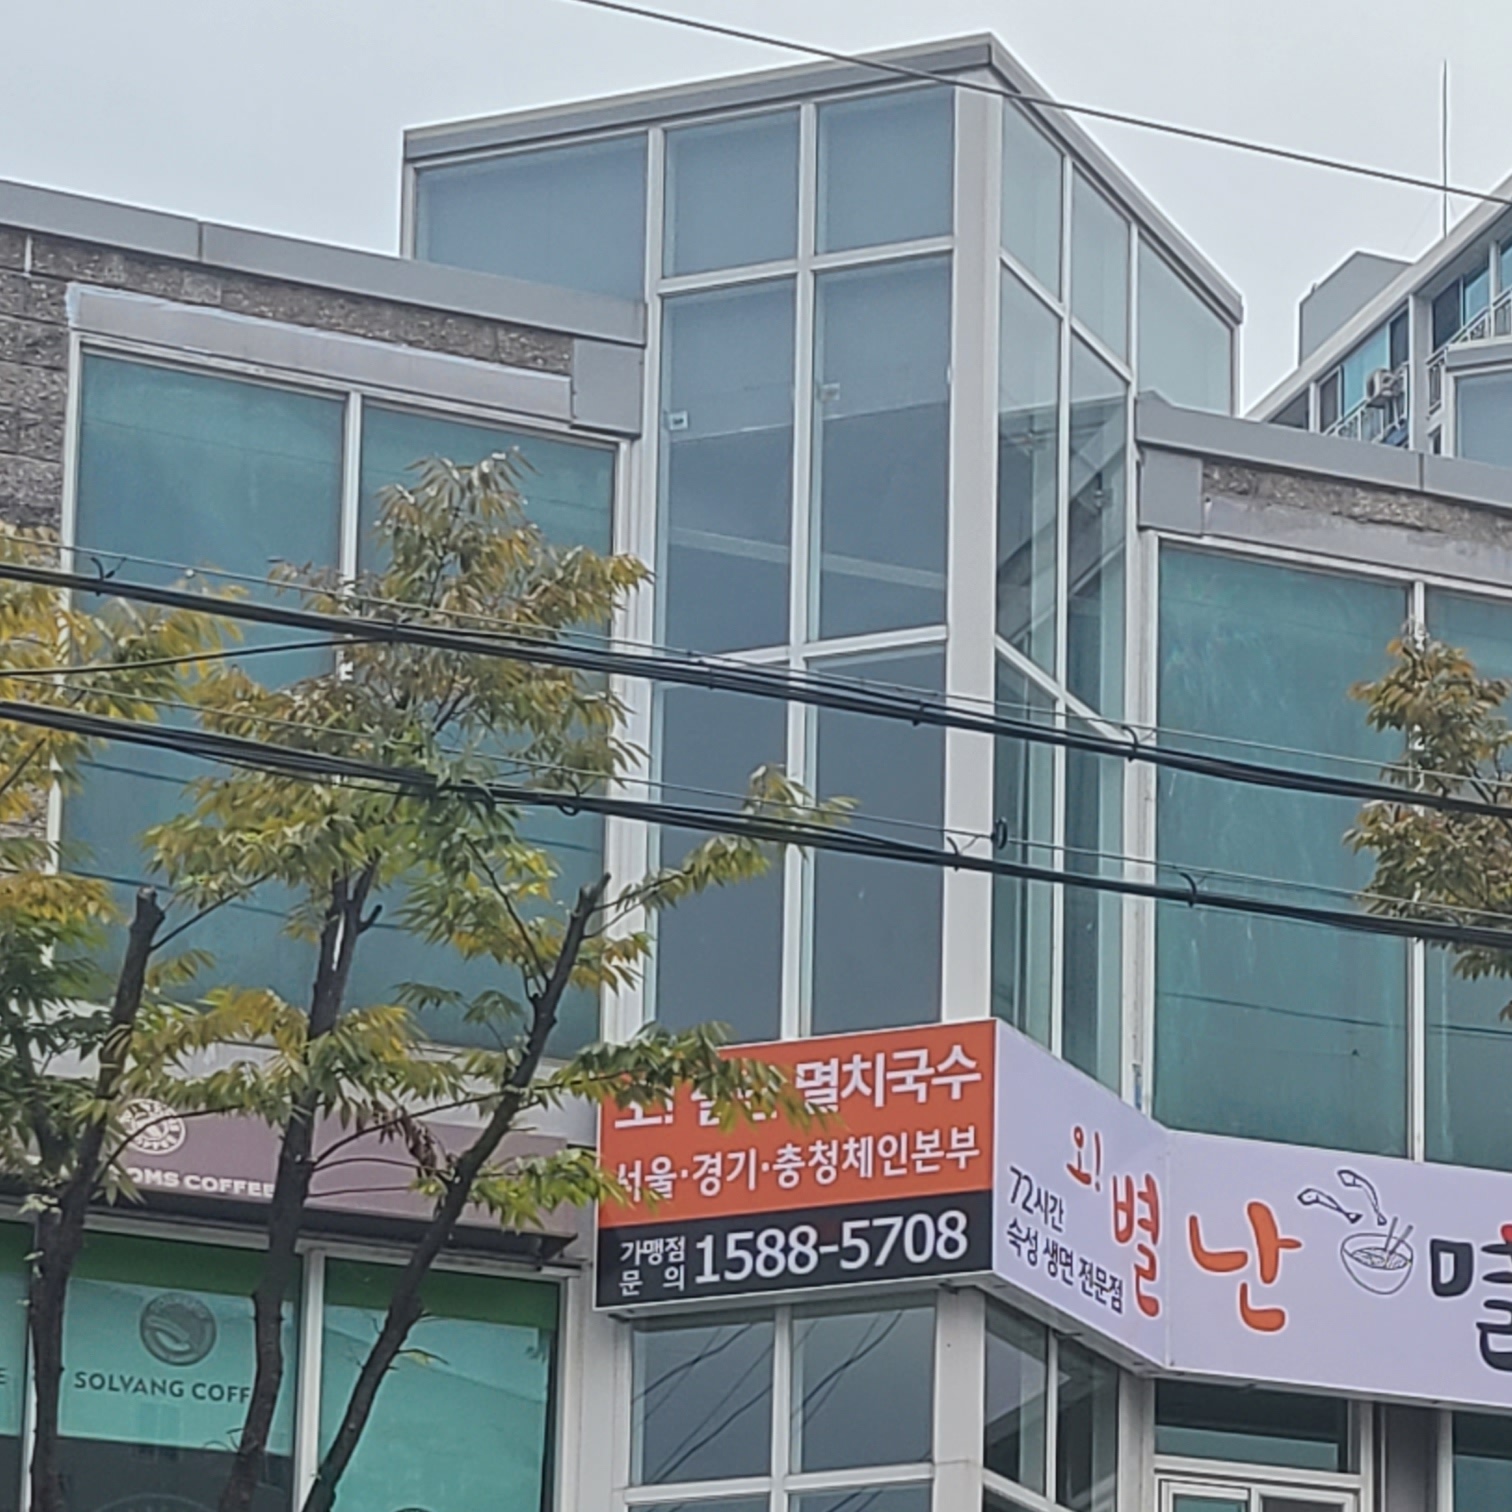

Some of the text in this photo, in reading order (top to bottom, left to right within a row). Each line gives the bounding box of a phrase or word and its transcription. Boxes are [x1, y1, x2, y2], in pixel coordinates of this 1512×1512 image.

[796, 1044, 982, 1114] 멸치국수
[184, 1175, 276, 1198] COFFEE
[1009, 1165, 1063, 1233] 72시간
[619, 1236, 686, 1266] 가맹점
[695, 1209, 968, 1284] 1588-5708
[1006, 1218, 1123, 1314] 숙성 생면 전문점
[1112, 1173, 1302, 1333] 별난
[74, 1371, 184, 1398] SOLVANG
